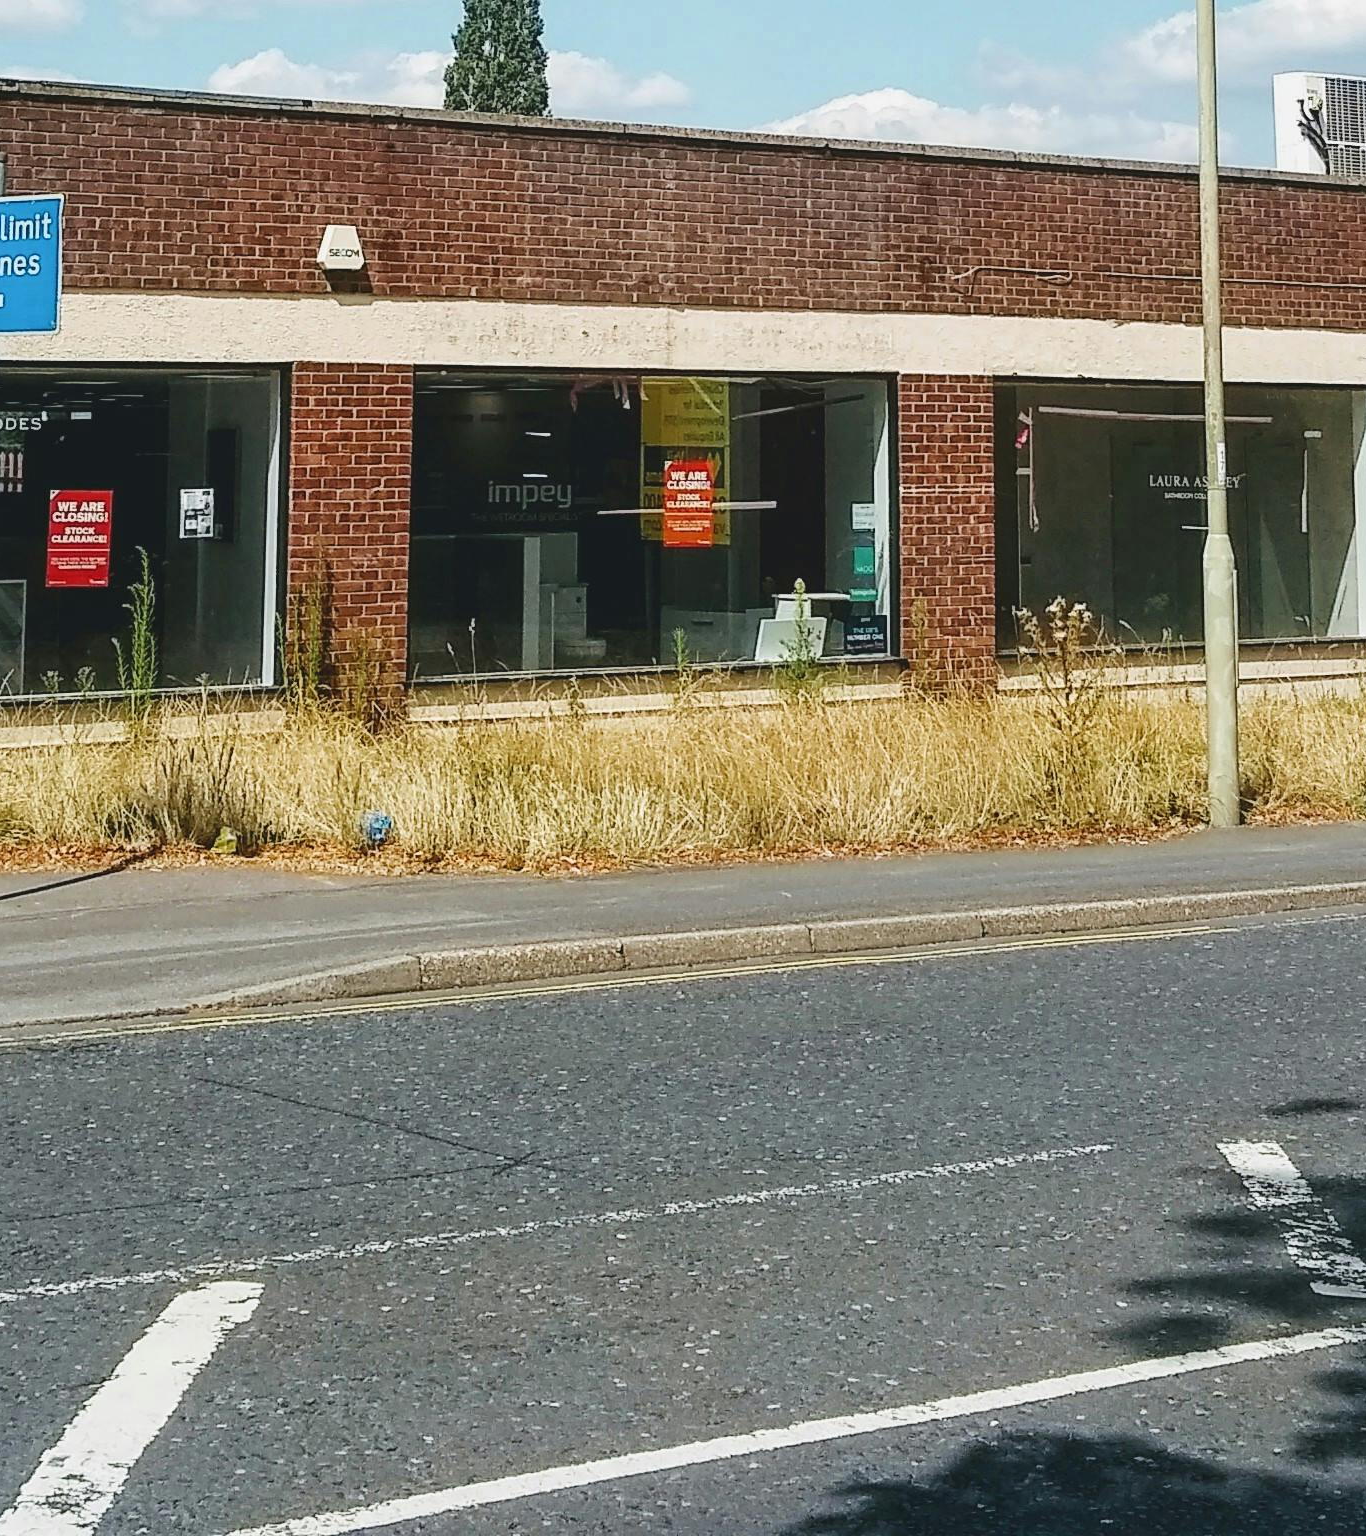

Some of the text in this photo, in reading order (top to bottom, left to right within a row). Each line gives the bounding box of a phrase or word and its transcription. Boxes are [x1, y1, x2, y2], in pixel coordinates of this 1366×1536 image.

[0, 212, 52, 242] limit
[671, 471, 707, 480] WE ARE
[1149, 475, 1240, 488] LAURA ASEY
[488, 480, 572, 510] impey
[57, 502, 105, 512] WE ARE
[52, 512, 109, 523] CLOSING!
[64, 527, 95, 535] STOCK
[51, 535, 107, 543] CLEARANCE!
